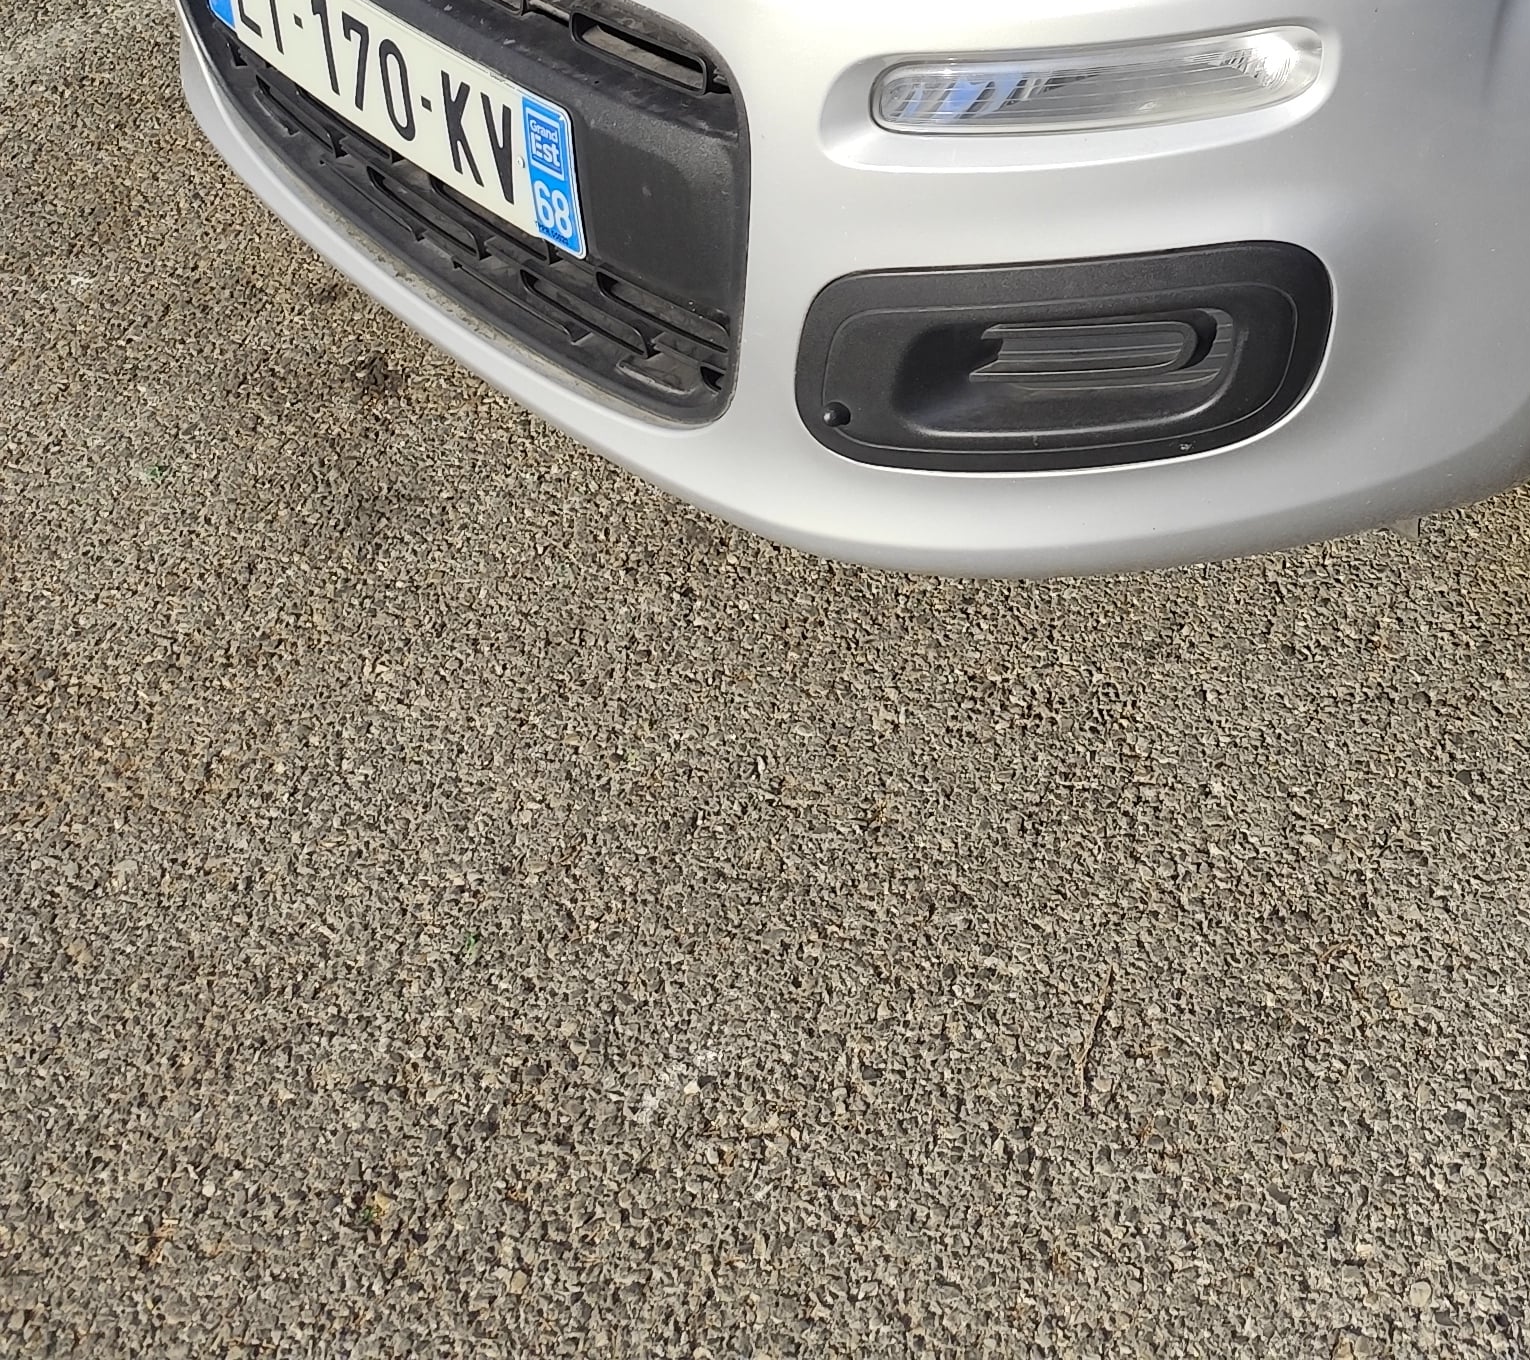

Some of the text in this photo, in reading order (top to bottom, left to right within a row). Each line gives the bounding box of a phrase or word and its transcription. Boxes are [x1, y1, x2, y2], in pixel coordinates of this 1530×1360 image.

[529, 119, 558, 144] Grand
[530, 133, 561, 168] Est
[533, 180, 573, 239] 68
